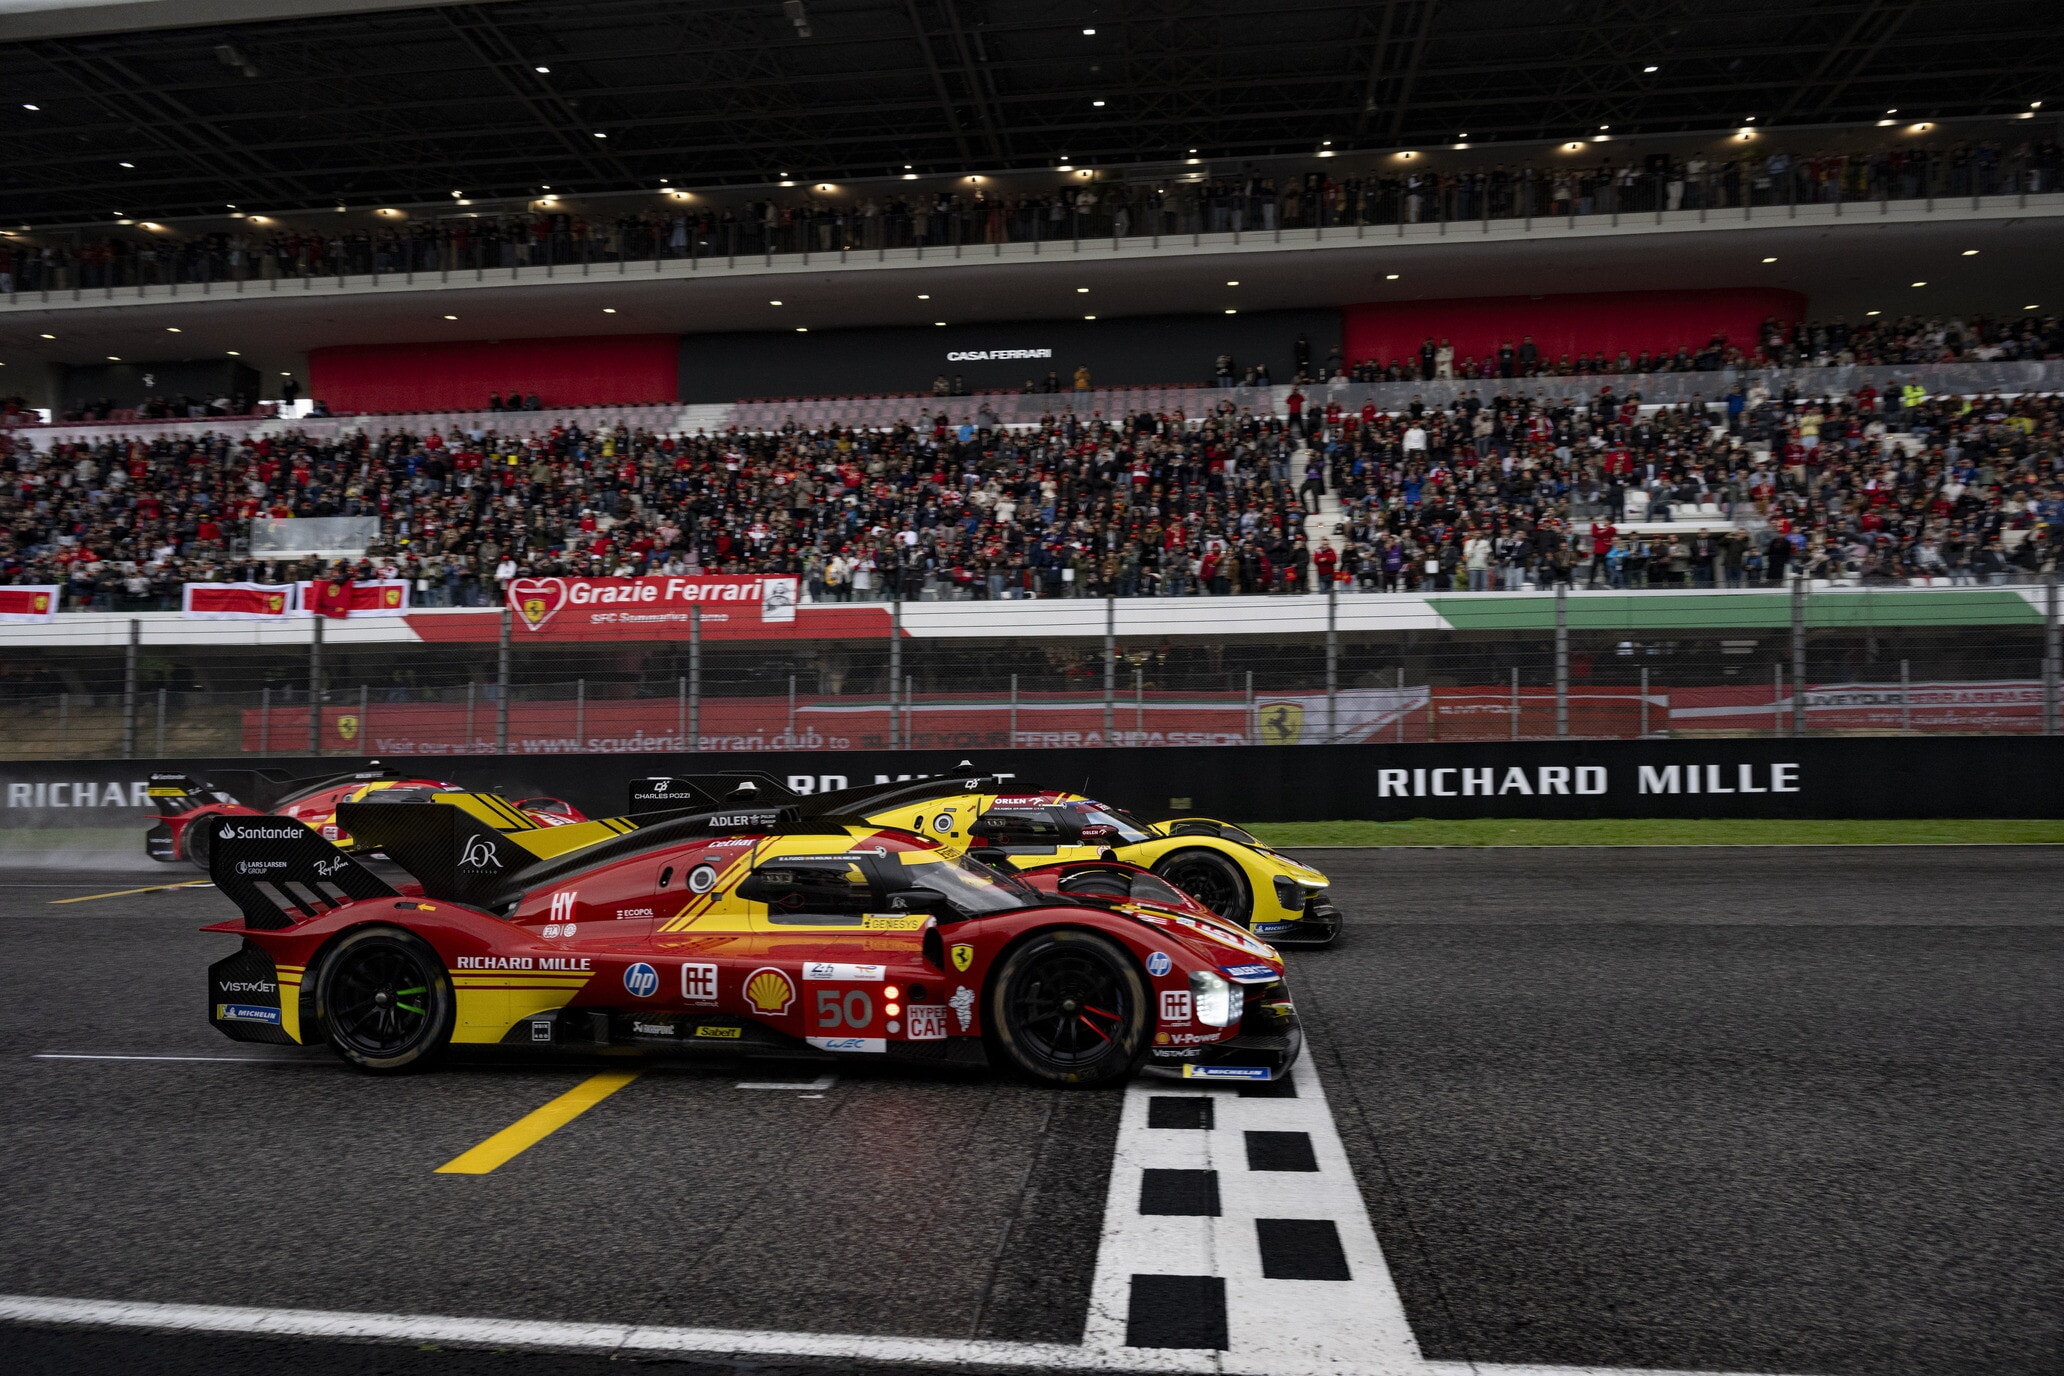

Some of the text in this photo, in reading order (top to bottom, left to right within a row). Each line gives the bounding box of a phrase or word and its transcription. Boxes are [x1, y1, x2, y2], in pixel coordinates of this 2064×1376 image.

[947, 349, 1052, 361] CASA FERRARI
[569, 578, 763, 604] Grazie Ferrari
[590, 613, 618, 624] SFC
[376, 738, 415, 754] Visit
[418, 741, 446, 754] our
[829, 736, 851, 750] to
[1378, 763, 1801, 798] RICHARD MILLE
[8, 781, 157, 808] RICHAR
[634, 792, 668, 800] CHARLES
[708, 815, 749, 827] ADLER
[237, 826, 304, 840] Santander
[708, 839, 757, 848] Cetilar
[550, 892, 578, 921] HY
[624, 908, 653, 917] ECOPOL
[873, 920, 918, 929] GENESYS
[457, 957, 591, 971] RICHARD MILLE
[219, 979, 276, 993] VISTAJET
[238, 1010, 276, 1019] MICHELIN
[816, 990, 873, 1029] 50
[910, 1007, 947, 1018] HYPER
[701, 1027, 736, 1037] Sabelt
[911, 1019, 947, 1036] CAR
[1171, 1032, 1222, 1044] V-Power
[1207, 1068, 1262, 1076] MICHELIN
